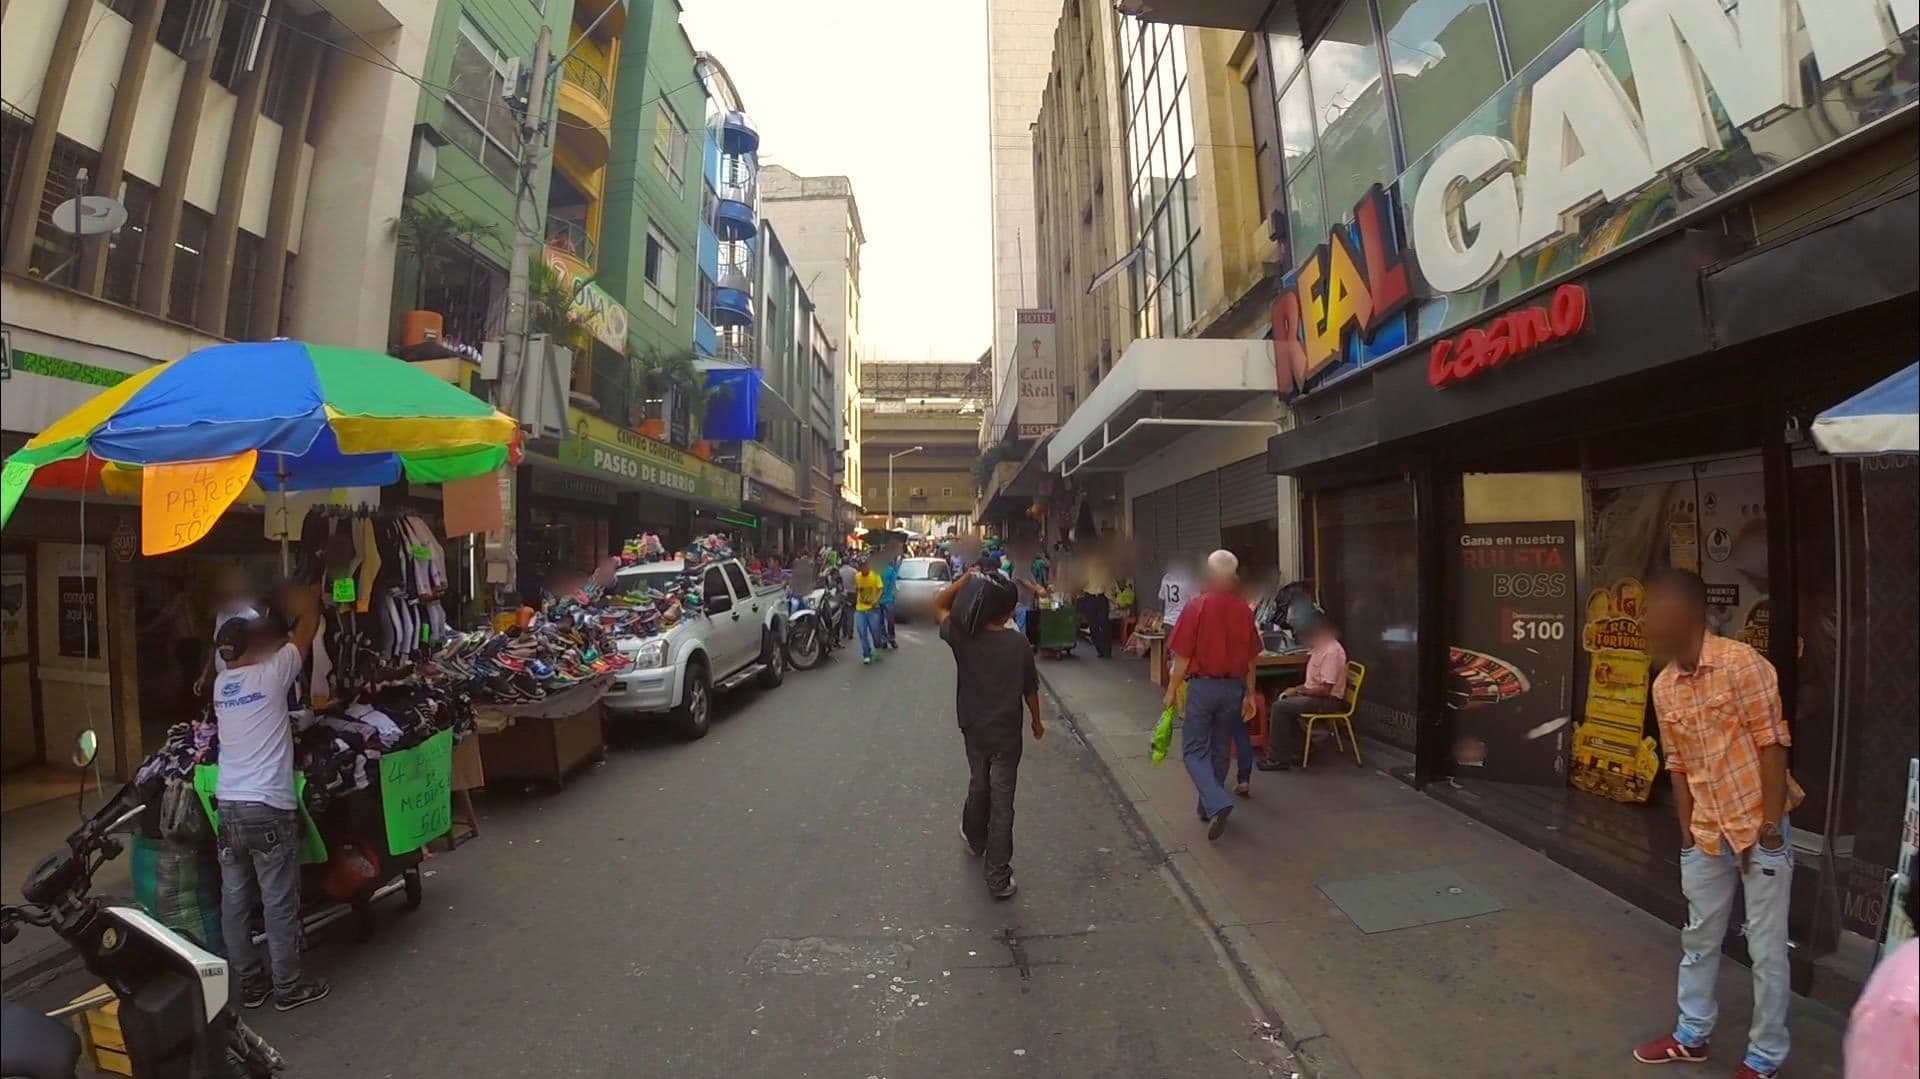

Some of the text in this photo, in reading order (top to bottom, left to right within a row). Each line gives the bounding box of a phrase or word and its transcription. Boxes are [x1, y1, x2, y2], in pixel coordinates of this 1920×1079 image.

[1413, 0, 1919, 293] GAM
[1272, 185, 1412, 399] REAL
[1019, 313, 1054, 323] HOTEL
[1020, 381, 1056, 399] Real
[192, 466, 216, 486] 4
[593, 449, 638, 478] PASEO
[641, 465, 657, 484] DE
[659, 470, 696, 493] BERRIO
[1460, 533, 1566, 546] Gana en nuestra
[1167, 584, 1180, 603] 13
[1492, 572, 1566, 598] BOSS
[1511, 619, 1565, 640] $100
